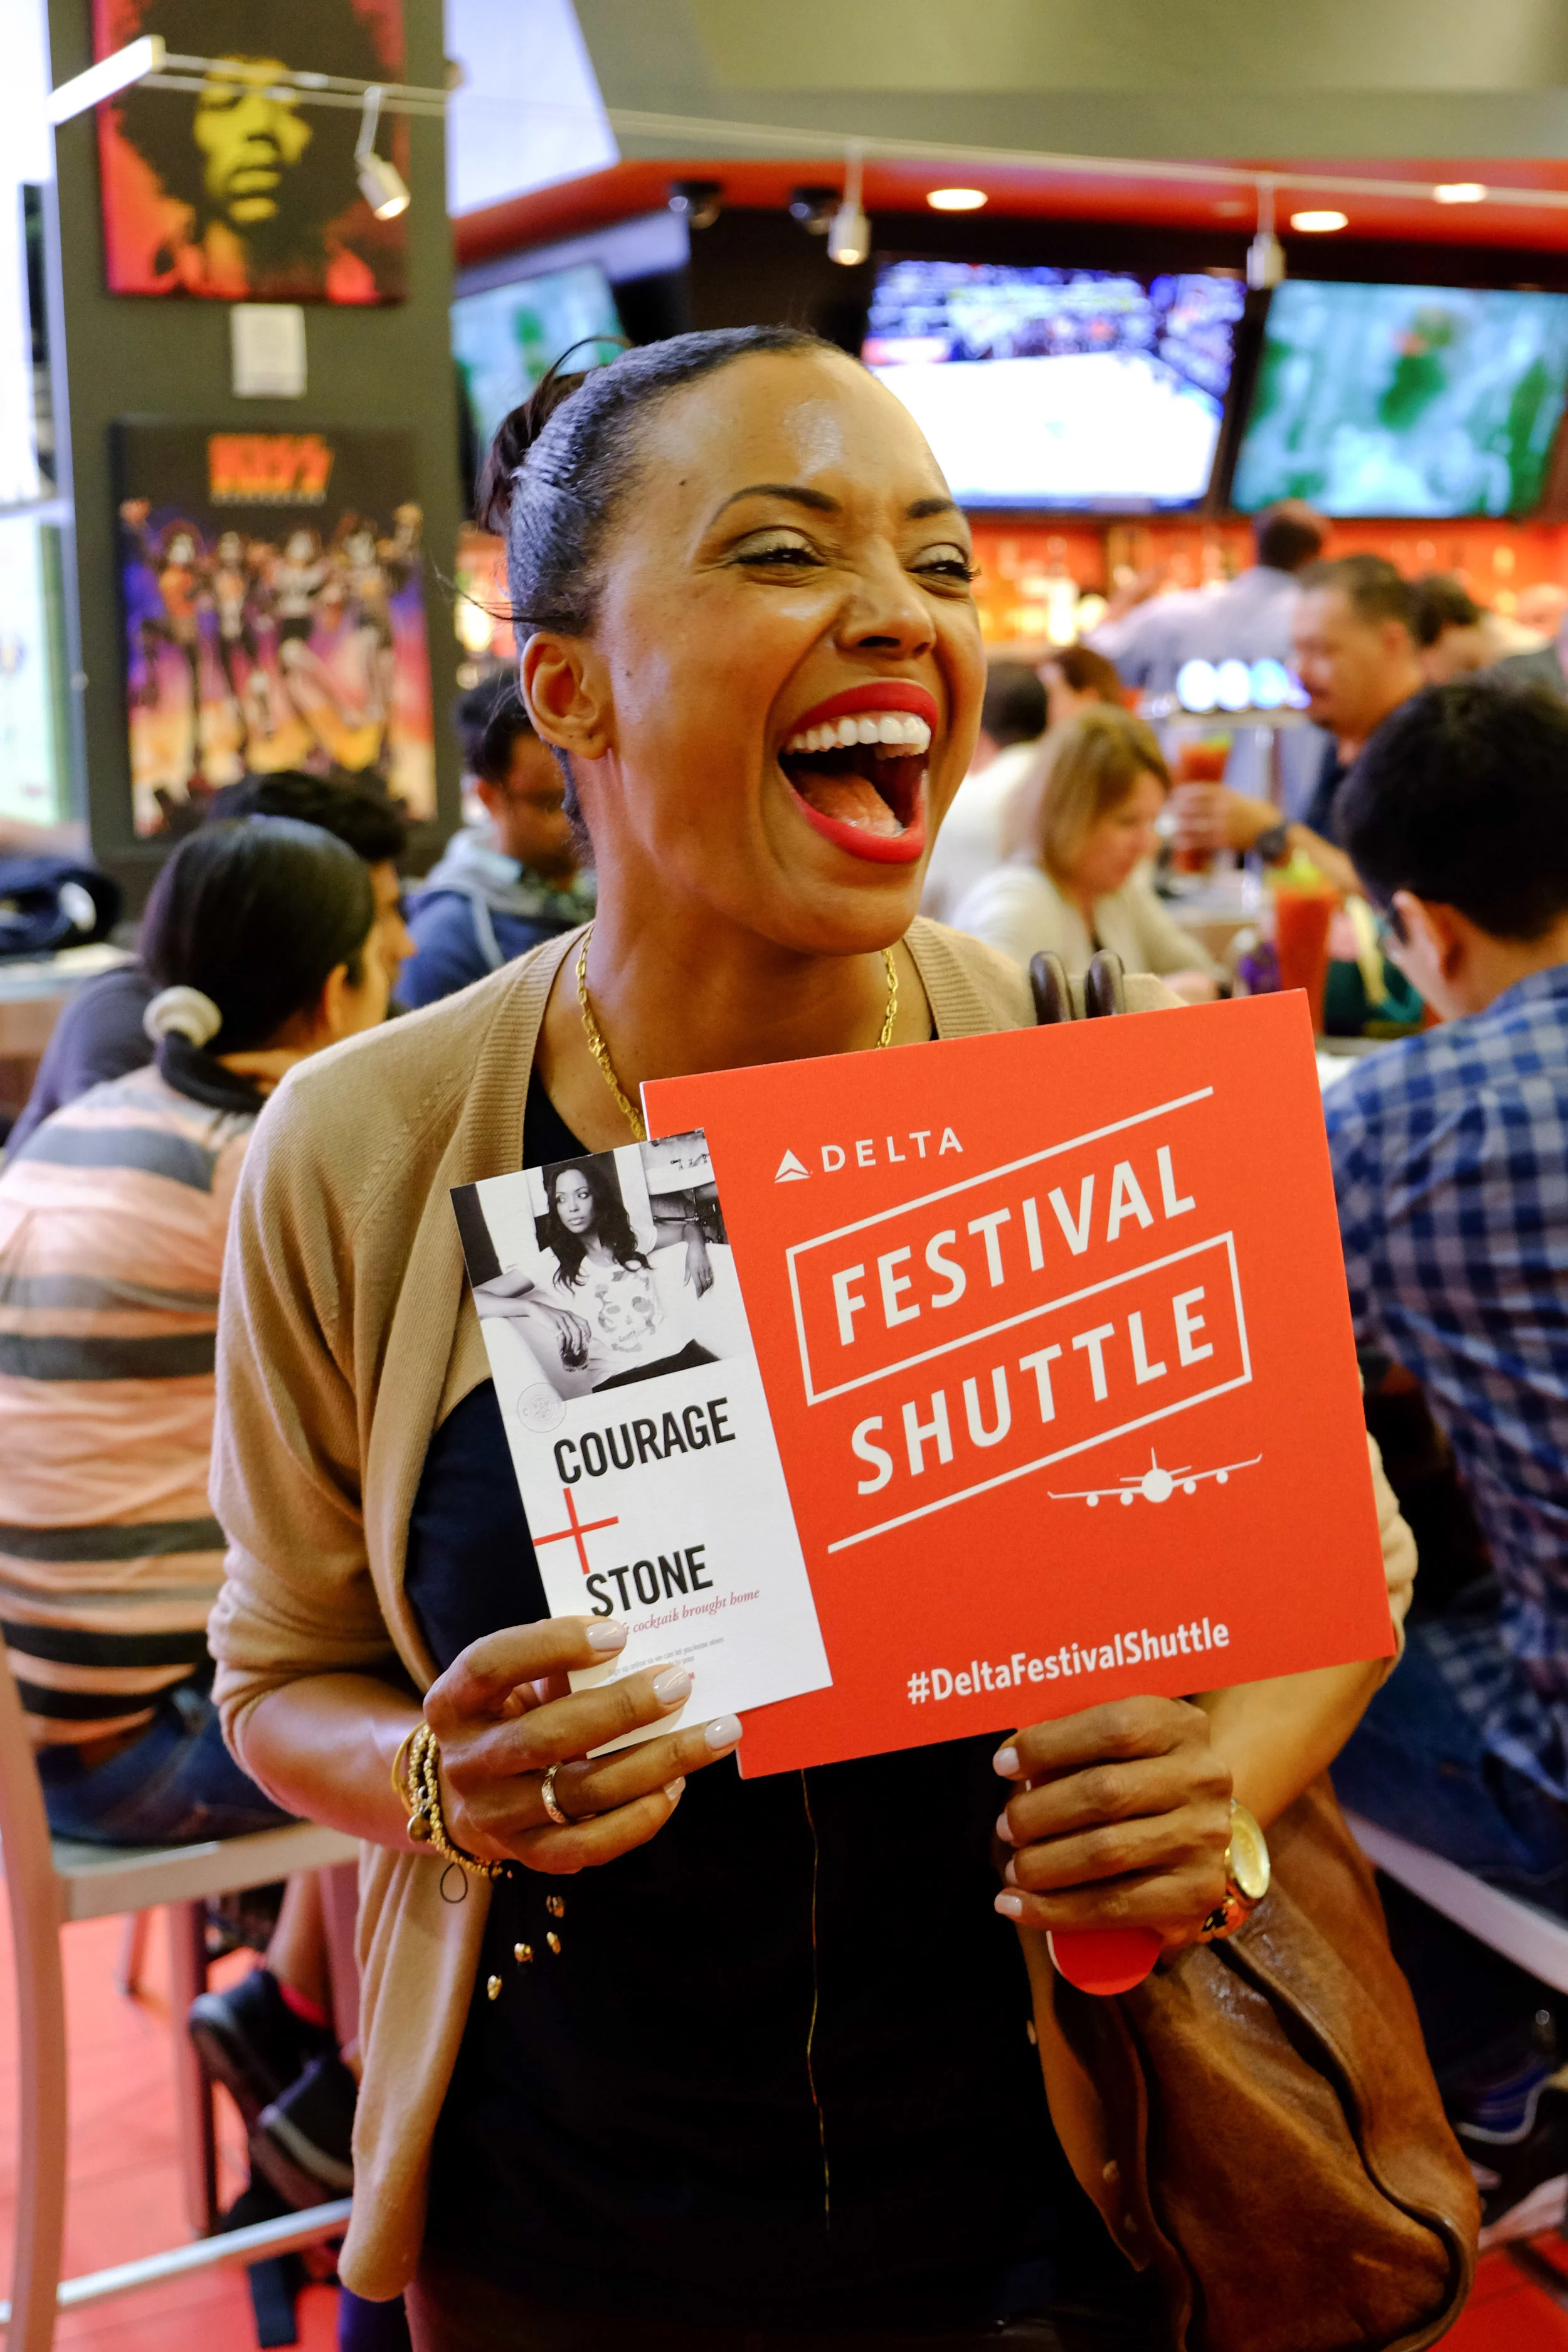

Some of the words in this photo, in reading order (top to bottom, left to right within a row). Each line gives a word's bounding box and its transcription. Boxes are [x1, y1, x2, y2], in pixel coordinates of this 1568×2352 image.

[821, 1127, 963, 1172] DELTA
[832, 1145, 1196, 1346] FESTIVAL
[851, 1285, 1214, 1495] SHUTTLE
[554, 1397, 736, 1484] COURAGE
[586, 1544, 714, 1617] STONE
[632, 1608, 680, 1633] cocktails
[682, 1596, 727, 1619] brought
[729, 1589, 760, 1605] home
[907, 1617, 1229, 1705] #DeltaFestivalShuttle
